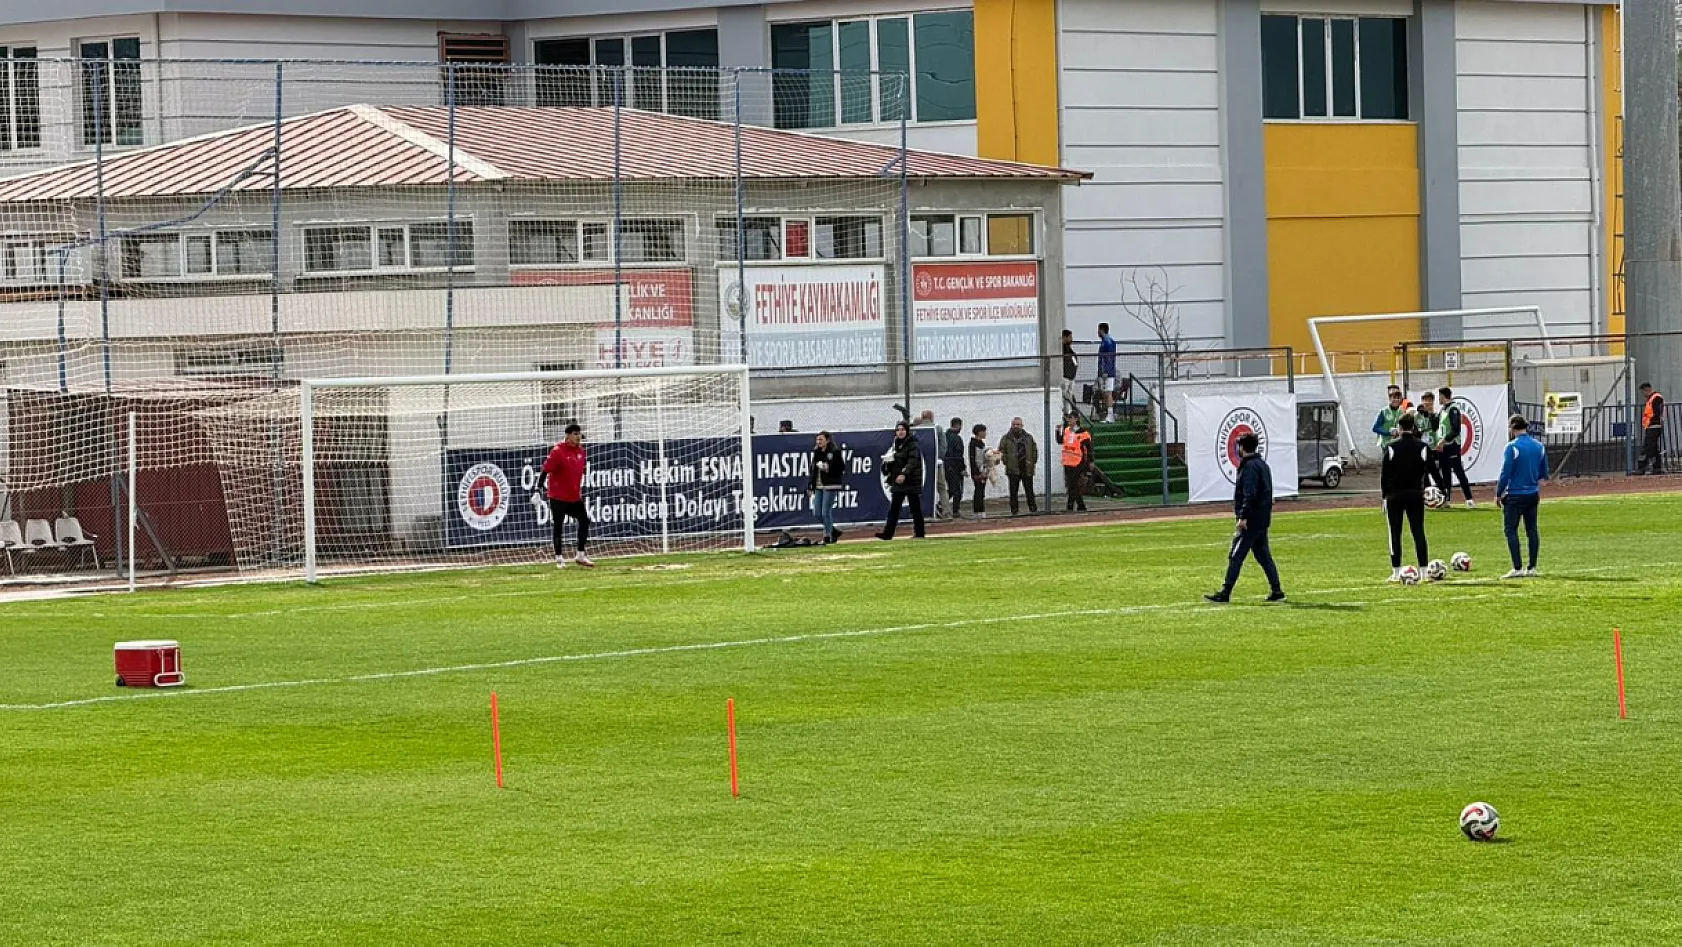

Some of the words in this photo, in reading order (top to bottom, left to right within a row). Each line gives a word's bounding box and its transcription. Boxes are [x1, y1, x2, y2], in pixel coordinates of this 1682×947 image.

[650, 282, 666, 298] VE
[976, 276, 984, 289] VE
[985, 275, 1002, 288] SPOR
[755, 274, 798, 324] FETHİYE
[799, 272, 881, 324] KAYMAKAMLIĞI
[916, 304, 939, 322] FETHİYE
[963, 307, 972, 320] VE
[973, 306, 987, 320] SPOR
[582, 461, 634, 487] kman
[640, 457, 695, 485] Hekim
[701, 455, 743, 481] ESNA
[675, 492, 728, 522] Dolayı
